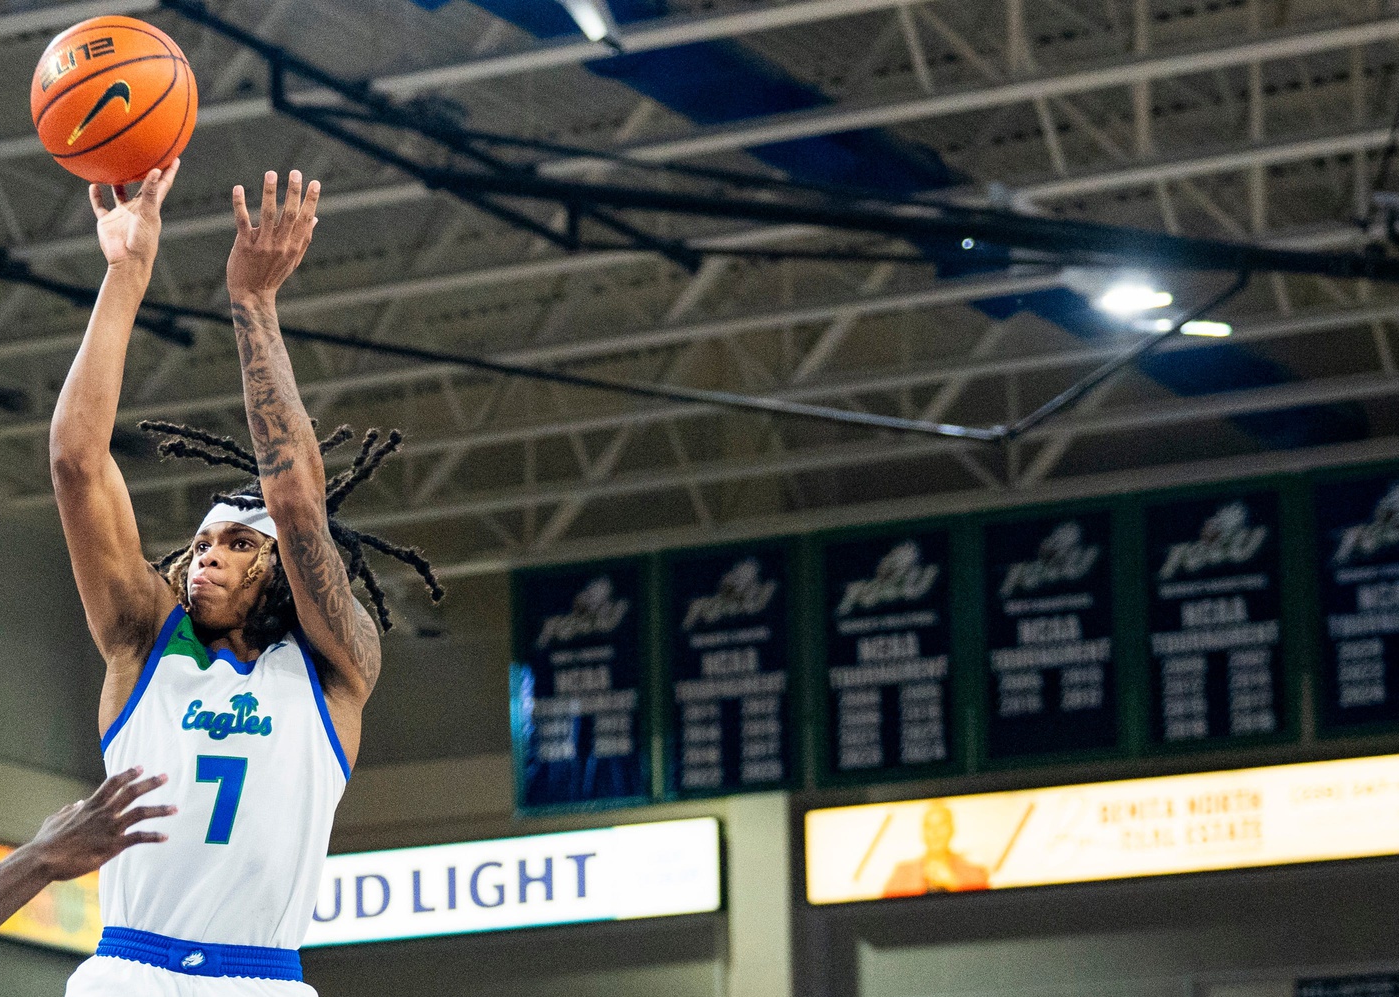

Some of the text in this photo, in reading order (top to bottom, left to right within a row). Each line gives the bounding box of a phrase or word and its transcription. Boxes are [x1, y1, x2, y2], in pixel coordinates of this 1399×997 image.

[181, 692, 273, 741] Eagles
[195, 754, 249, 845] 7
[412, 852, 597, 914] LIGHT
